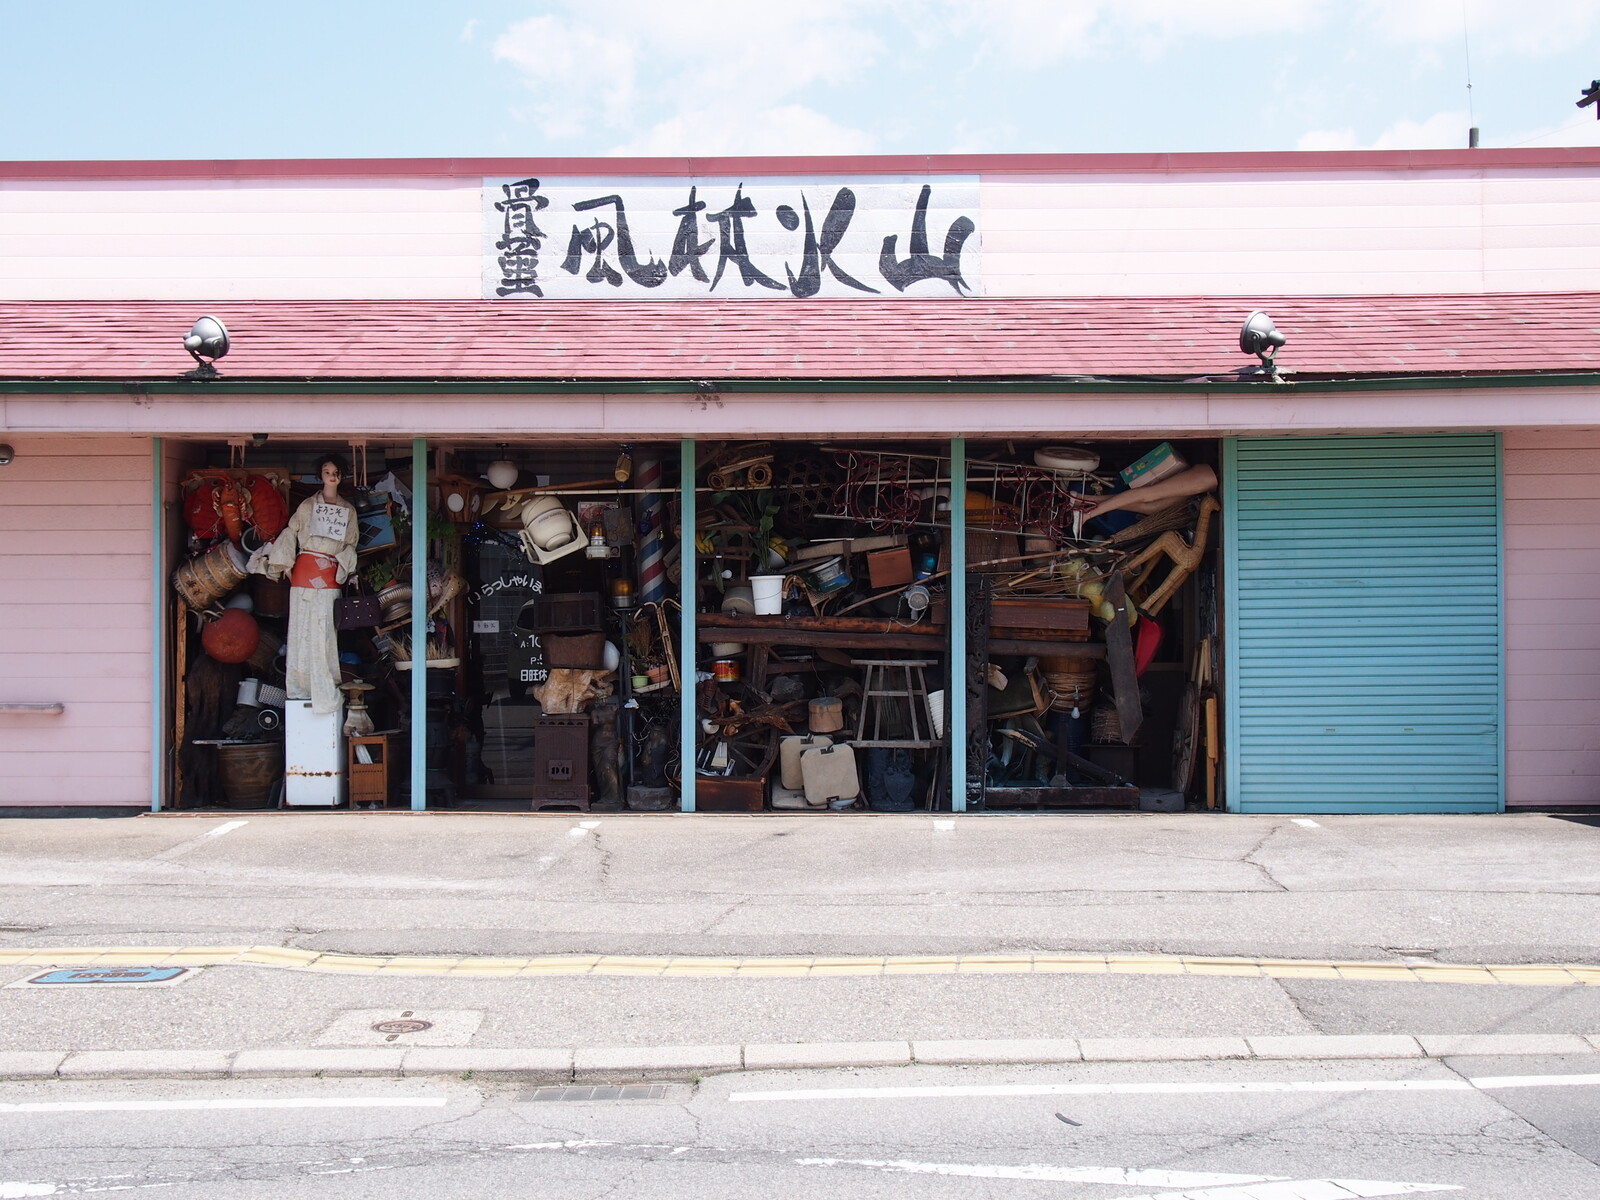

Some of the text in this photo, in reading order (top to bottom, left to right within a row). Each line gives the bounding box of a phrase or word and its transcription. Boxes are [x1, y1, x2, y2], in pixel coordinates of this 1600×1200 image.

[560, 182, 976, 297] 風林火山
[315, 504, 344, 518] ようこそ
